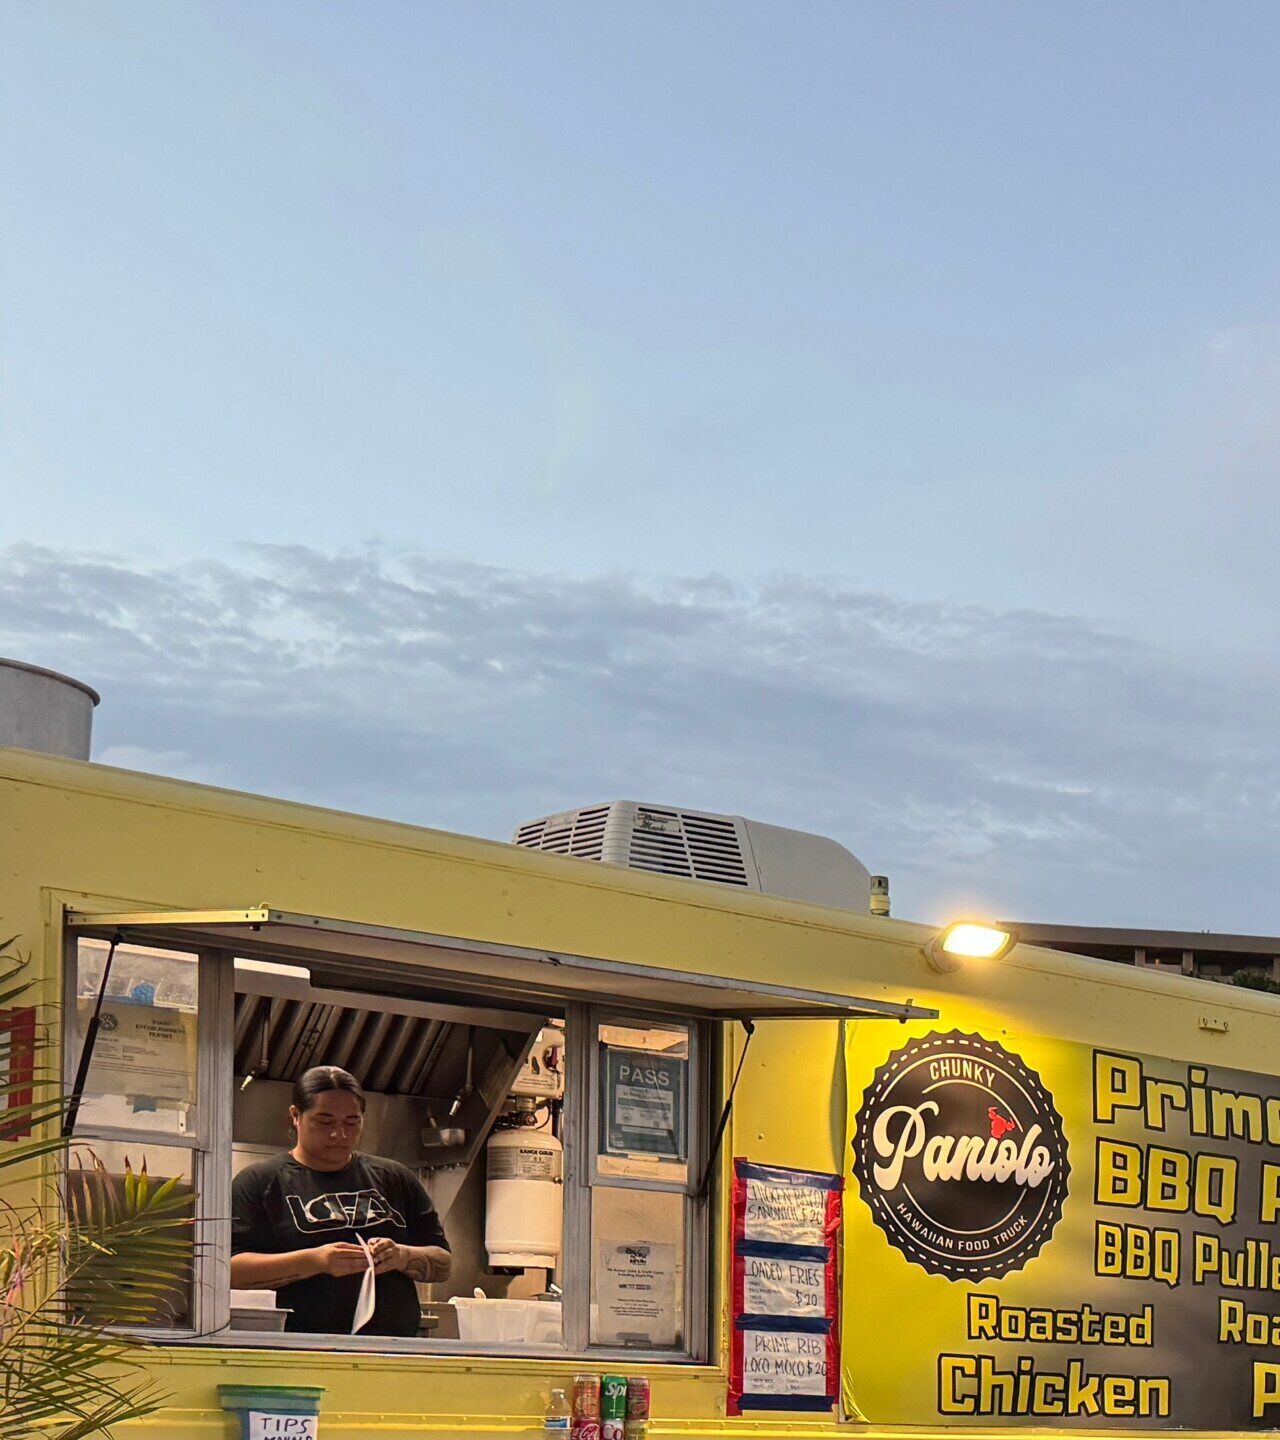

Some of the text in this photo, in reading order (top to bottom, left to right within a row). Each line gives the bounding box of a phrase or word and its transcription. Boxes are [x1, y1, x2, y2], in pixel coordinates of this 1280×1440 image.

[619, 1066, 670, 1086] PASS
[930, 1059, 995, 1088] CHUNKY
[873, 1100, 1054, 1190] Paniolo
[1096, 1139, 1239, 1226] BBQ
[896, 1203, 1028, 1251] HAWAIIAN FOOD TRUCK
[1096, 1223, 1180, 1287] BBQ
[744, 1261, 820, 1287] LOADED FRIES
[795, 1290, 818, 1307] $20
[968, 1295, 1154, 1346] Roasted
[755, 1335, 822, 1355] PRIME RIB
[744, 1357, 828, 1377] LOCO MOCO $20
[939, 1354, 1169, 1416] Chicken
[261, 1418, 312, 1434] TIPS
